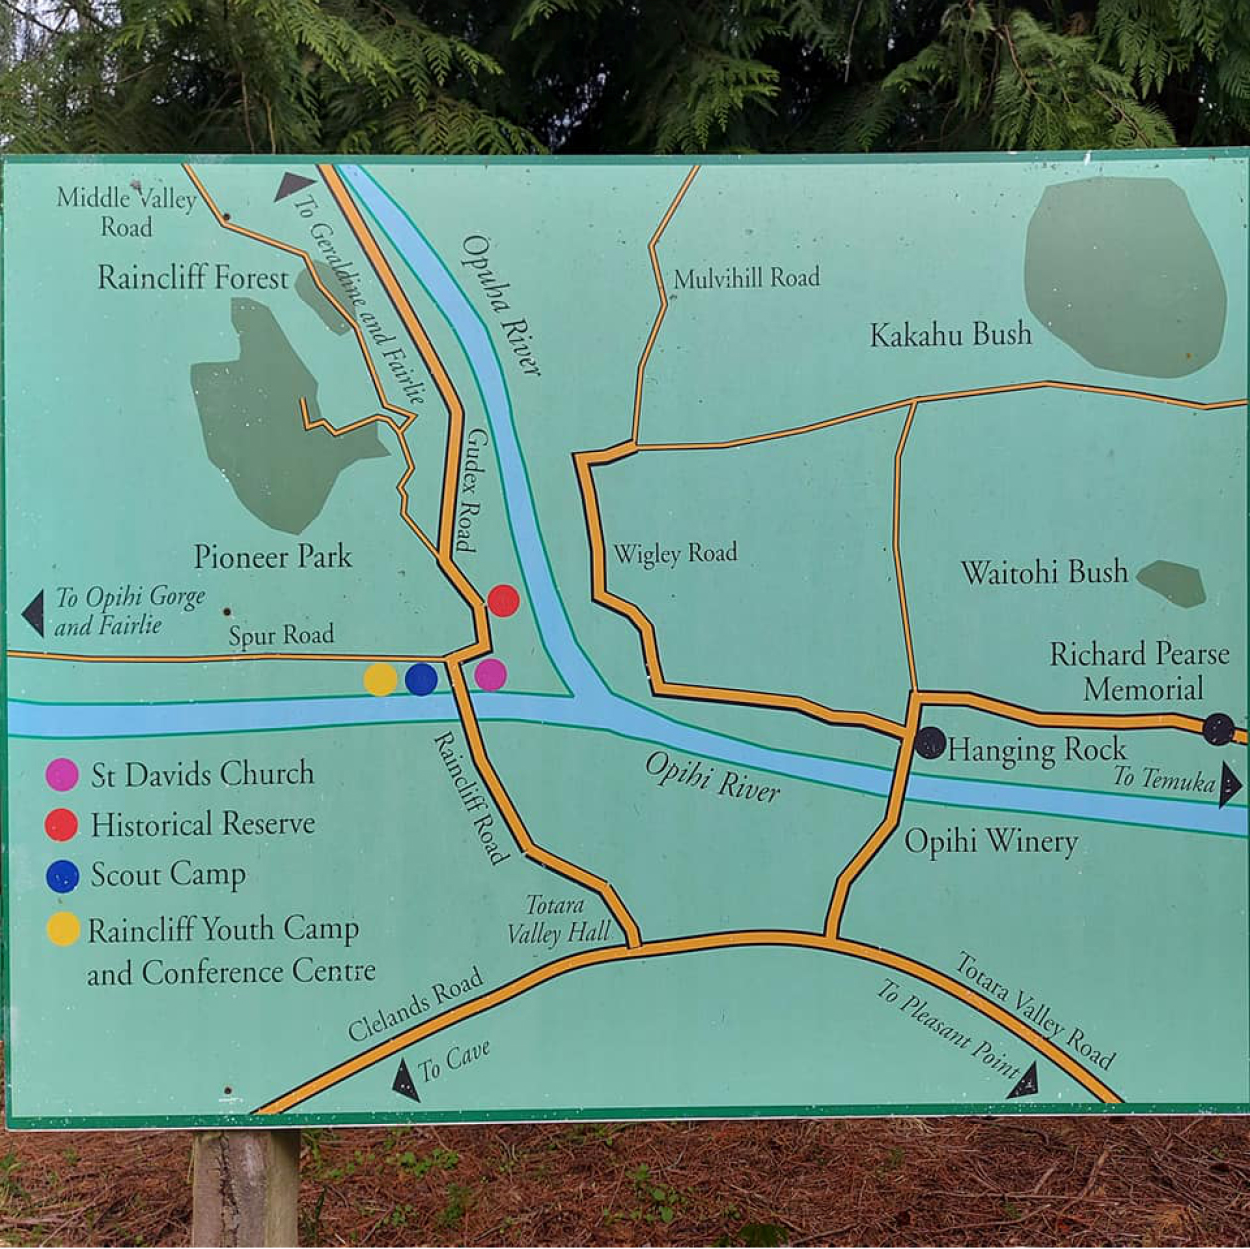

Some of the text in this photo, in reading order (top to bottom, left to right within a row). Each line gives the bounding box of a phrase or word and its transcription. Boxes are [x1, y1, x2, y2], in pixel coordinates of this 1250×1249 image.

[57, 186, 197, 215] Middle Valley
[101, 215, 152, 237] Road
[98, 263, 289, 289] Raincliff Forest
[674, 266, 821, 290] Mulvihill Road
[294, 194, 425, 405] To Geraldine and Fairlie
[461, 235, 541, 377] Opuha River
[869, 319, 1032, 348] Kakahu Bush
[456, 428, 489, 553] Gudex Road
[195, 543, 352, 569] Pioneer Park
[614, 541, 738, 569] Wigley Road
[961, 558, 1128, 584] Waitohi Bush
[56, 584, 206, 613] To Opihi Gorge
[54, 611, 162, 636] and Fairlie
[229, 623, 334, 651] Spur Road
[1050, 640, 1230, 667] Richard Pearse
[1083, 676, 1204, 702] Memorial
[948, 736, 1127, 768] Hanging Rock
[90, 758, 314, 789] St Davids Church
[646, 751, 781, 803] Opihi River
[1115, 765, 1216, 792] To Temuka
[435, 731, 510, 866] Raincliff Road
[91, 810, 315, 838] Historical Reserve
[905, 827, 1079, 860] Opihi Winery
[91, 860, 246, 892] Scout Camp
[527, 894, 584, 915] Totara
[88, 914, 360, 947] Raincliff Youth Camp
[508, 920, 611, 949] Valley Hall
[87, 957, 376, 987] and Conference Centre
[348, 965, 484, 1042] Clelands Road
[956, 950, 1117, 1072] Totara Valley Road
[876, 978, 1022, 1081] To Pleasant Point
[417, 1039, 490, 1083] To Cave
